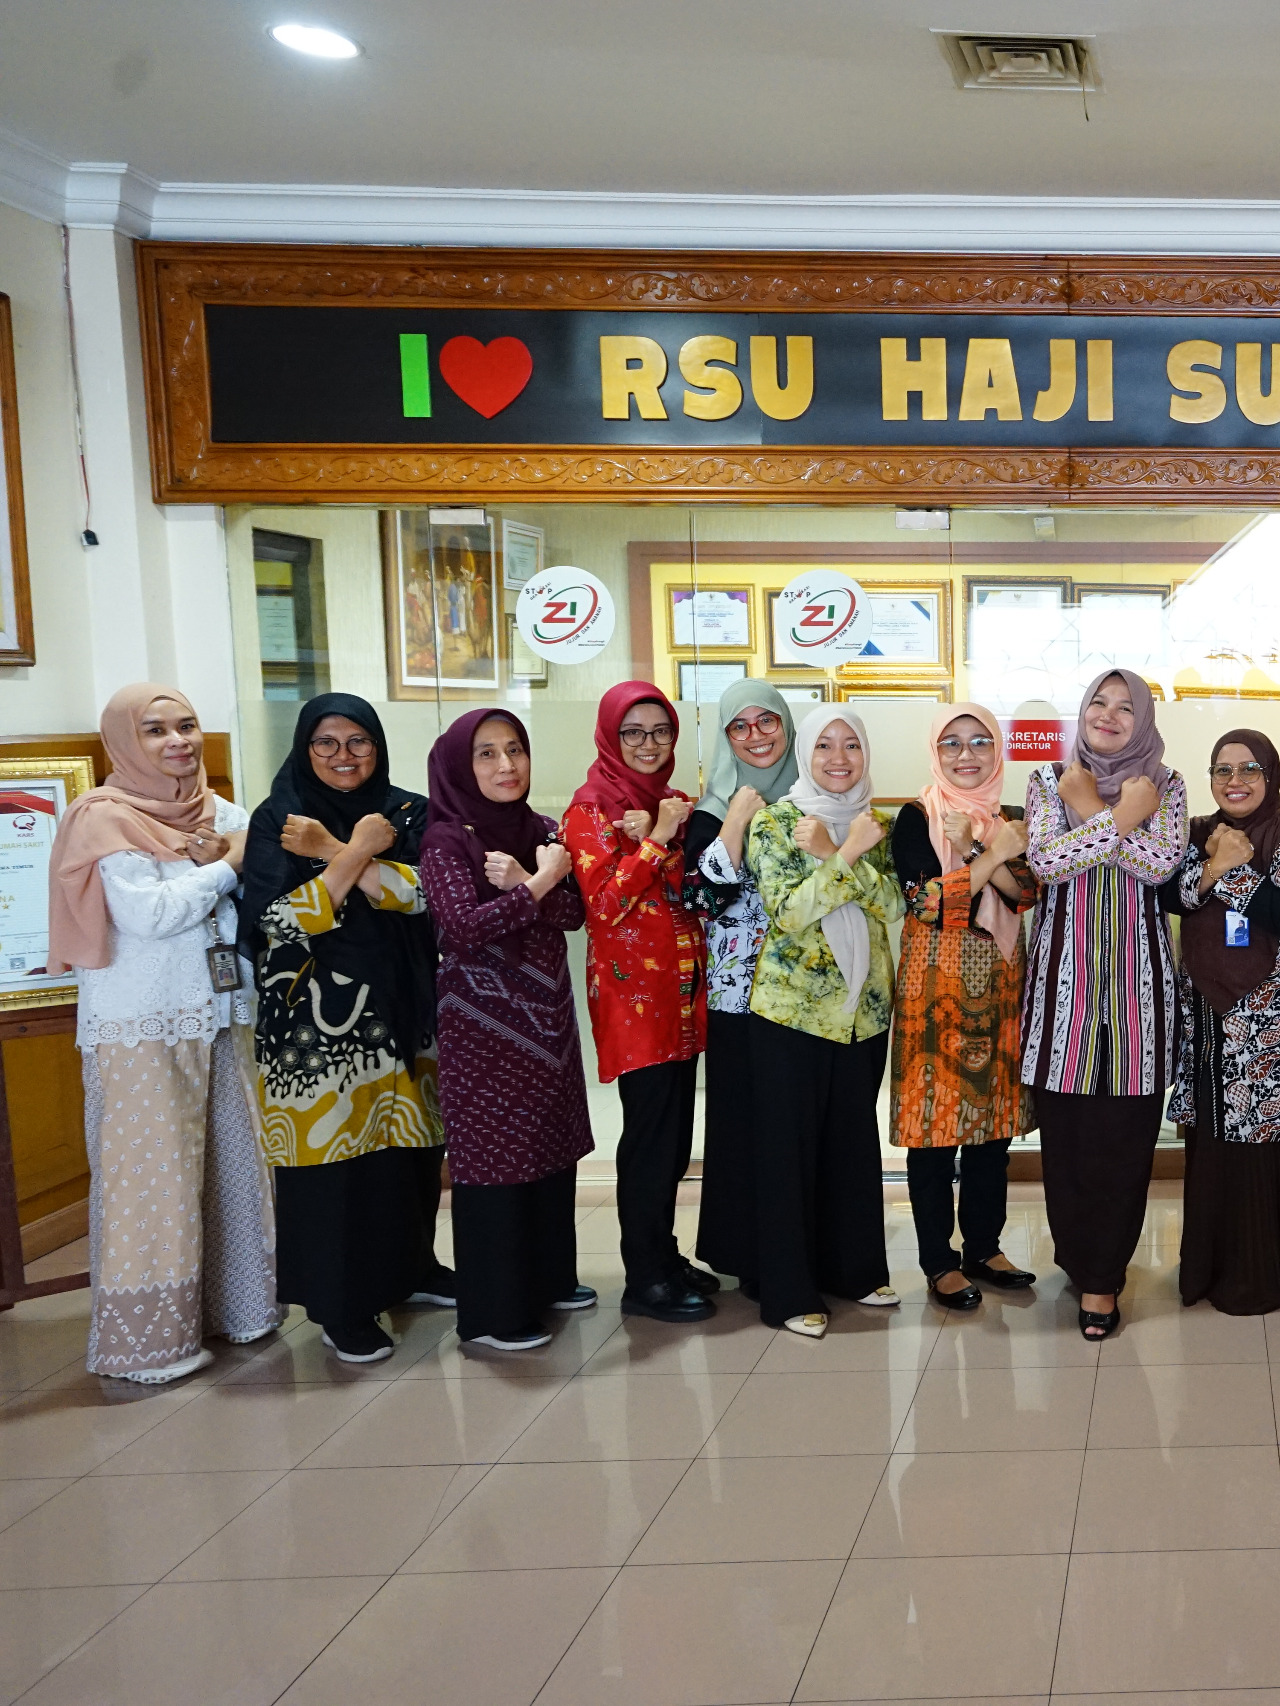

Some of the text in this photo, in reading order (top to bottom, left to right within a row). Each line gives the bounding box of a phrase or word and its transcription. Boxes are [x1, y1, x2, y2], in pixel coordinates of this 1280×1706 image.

[399, 333, 432, 418] I
[599, 335, 815, 421] RSU
[880, 337, 1114, 422] HAJI
[541, 602, 577, 623] ZI
[799, 605, 835, 626] ZI
[566, 606, 602, 645] JUJUR DAN AMANAH
[823, 609, 860, 648] JUJUR DAN AMANAH
[1002, 732, 1066, 741] EKRETARIS
[22, 841, 44, 849] SAKIT
